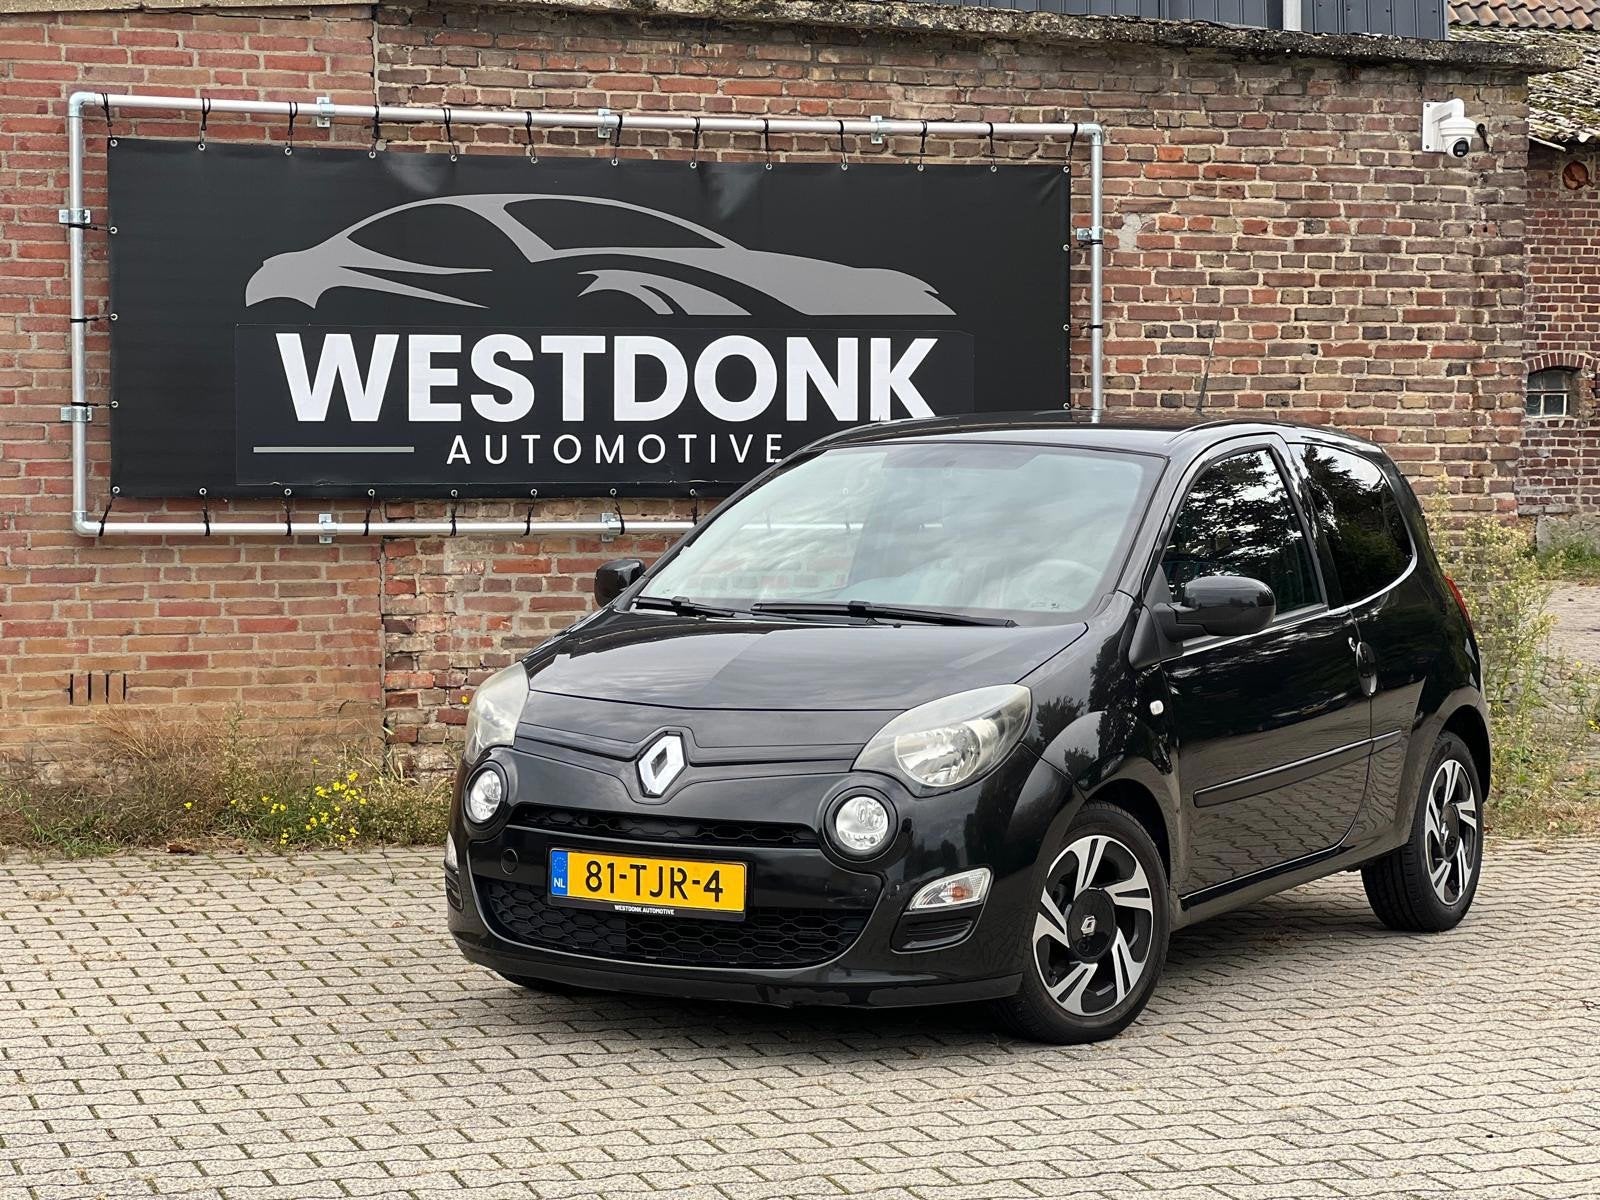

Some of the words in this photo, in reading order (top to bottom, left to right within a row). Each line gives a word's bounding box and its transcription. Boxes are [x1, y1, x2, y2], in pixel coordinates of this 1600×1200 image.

[275, 332, 939, 423] WESTDONK
[446, 433, 783, 466] AUTOMOTIVE
[553, 877, 566, 889] NL
[585, 860, 724, 903] 81-TJR-4
[614, 904, 642, 913] WESTDONK
[642, 907, 675, 915] AUTOMOTIVE
